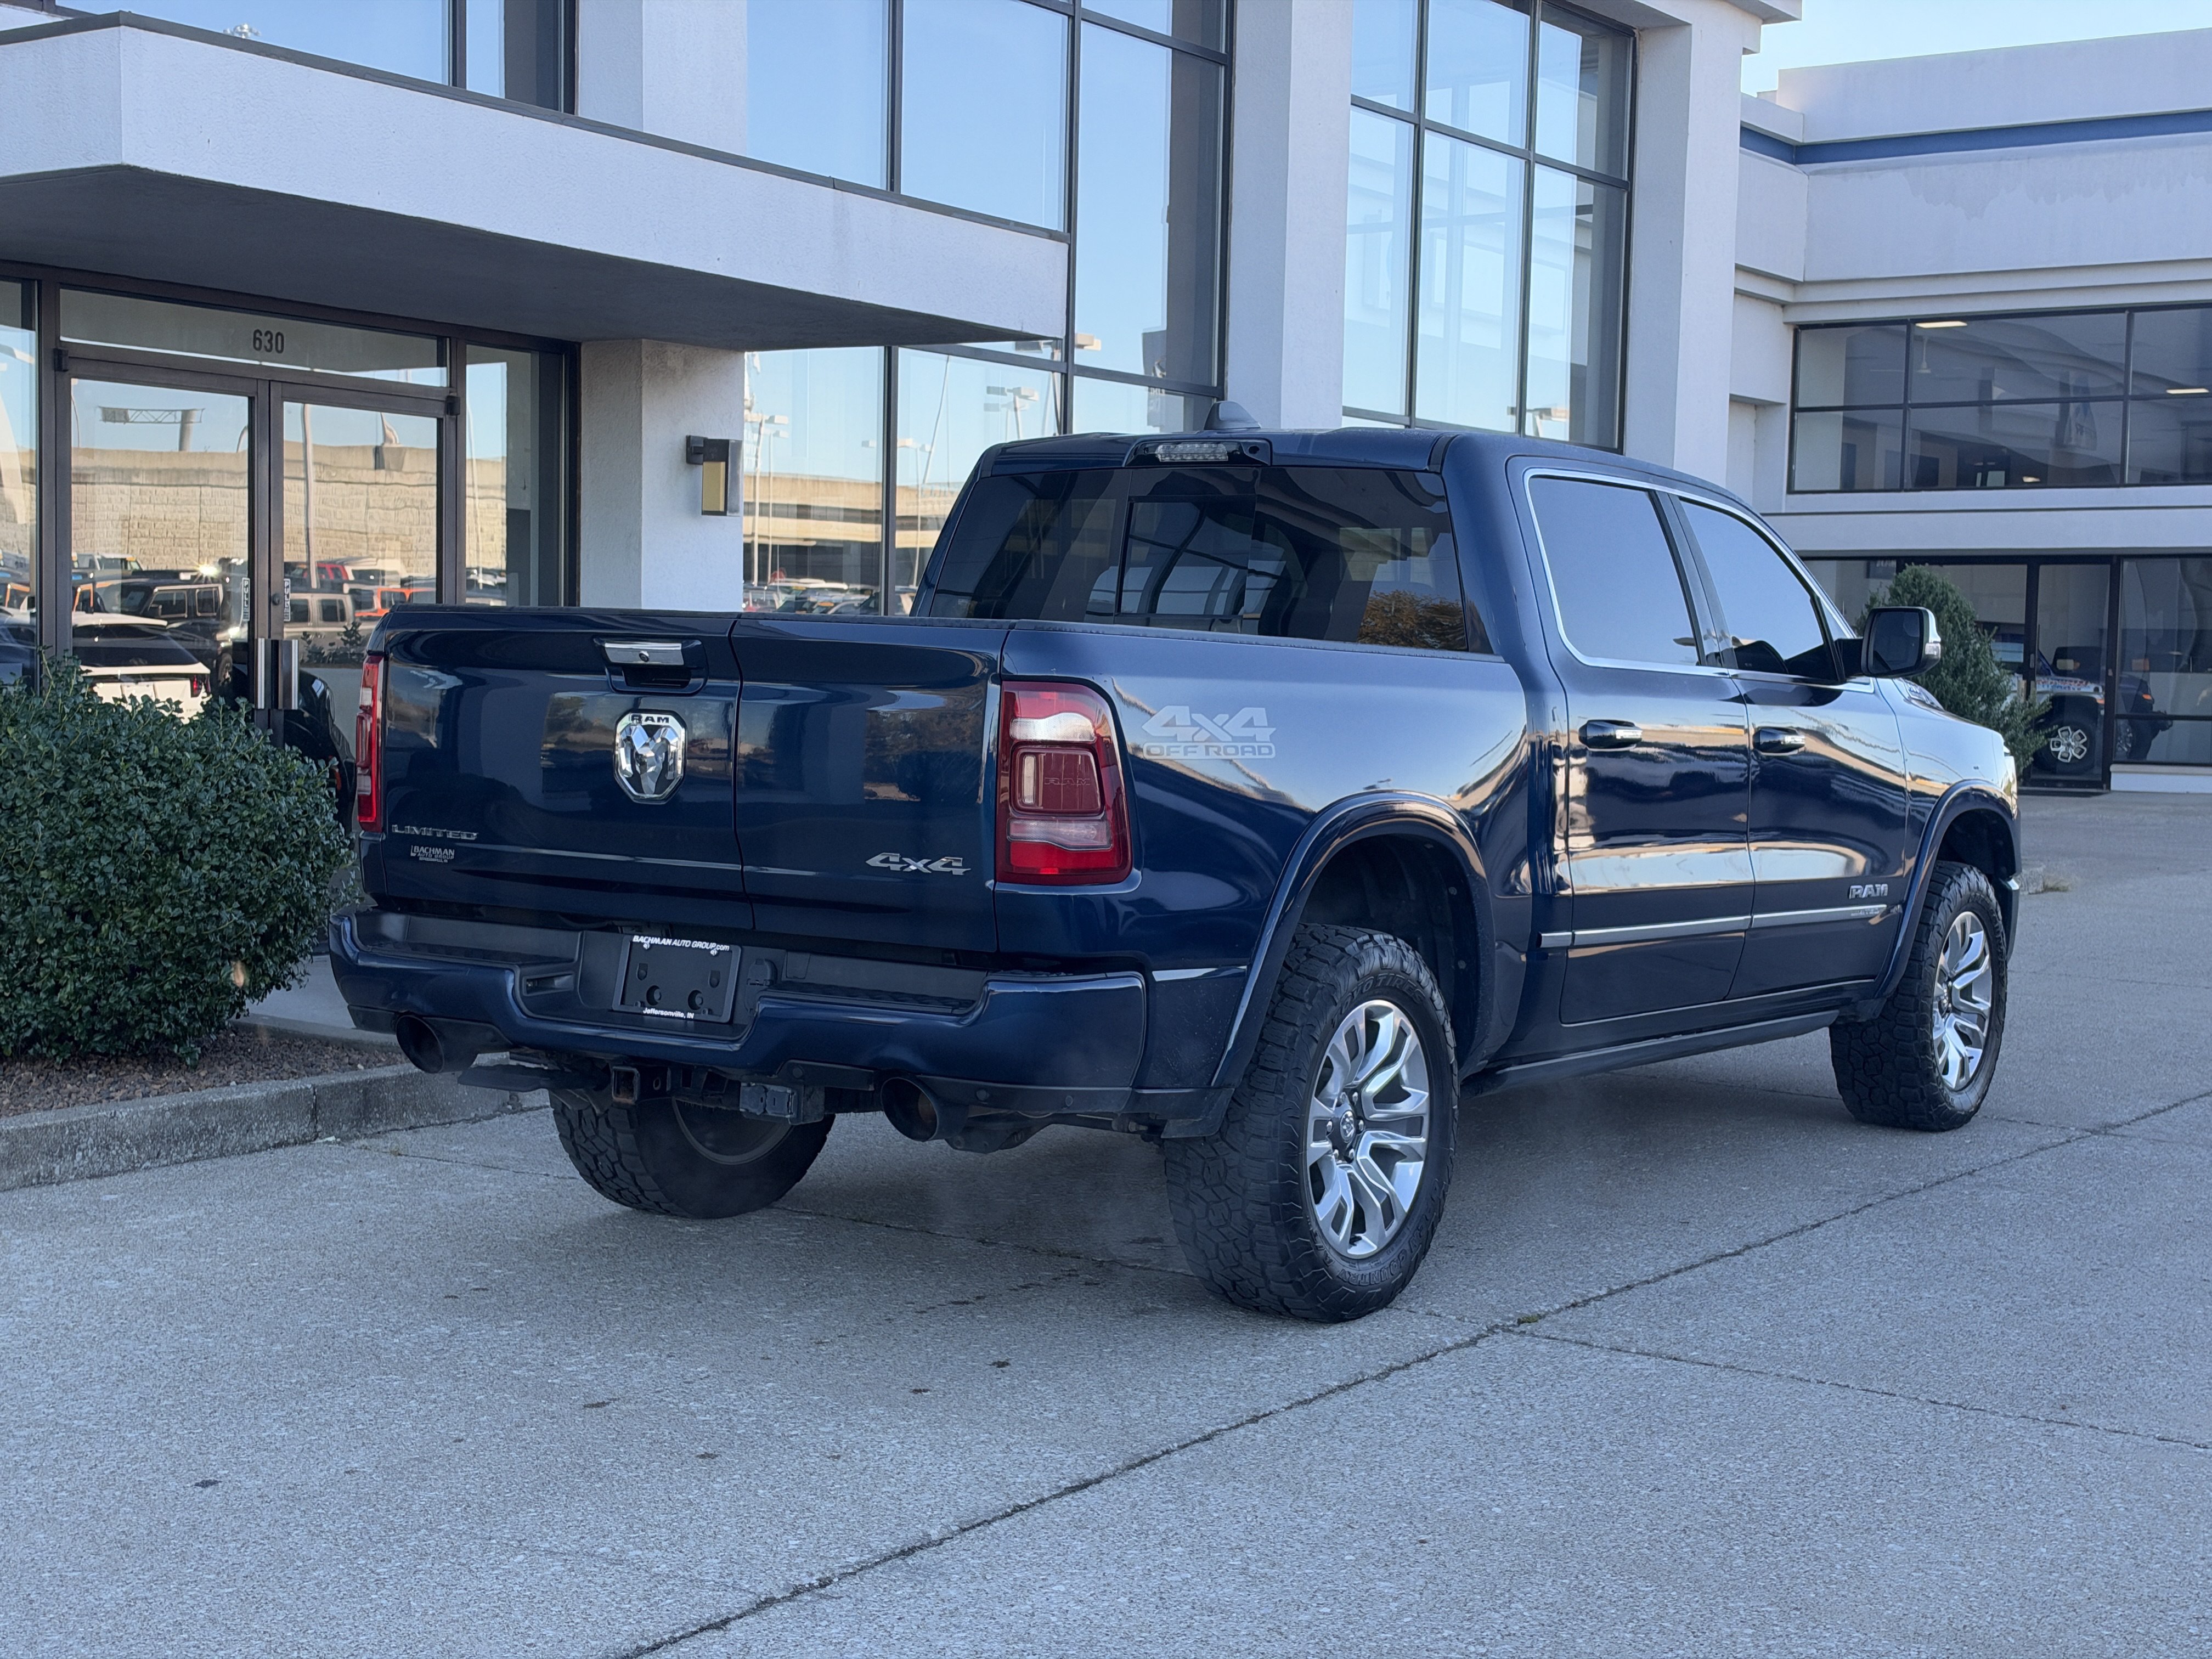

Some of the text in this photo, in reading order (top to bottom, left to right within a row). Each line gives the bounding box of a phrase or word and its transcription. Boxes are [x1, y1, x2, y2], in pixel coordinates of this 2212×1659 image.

[253, 329, 284, 354] 630
[630, 714, 669, 724] RAM
[1142, 706, 1277, 742] 4x4
[1146, 745, 1273, 757] OFF ROAD
[1044, 777, 1091, 786] RAM
[392, 824, 478, 840] LIMITED
[414, 845, 455, 856] BACHMAN
[1849, 884, 1888, 899] RAM
[633, 935, 672, 946] BACHMAN
[672, 939, 691, 948] AUTO
[1375, 973, 1426, 1005] TIRES
[1337, 1249, 1408, 1286] COUNTRY
